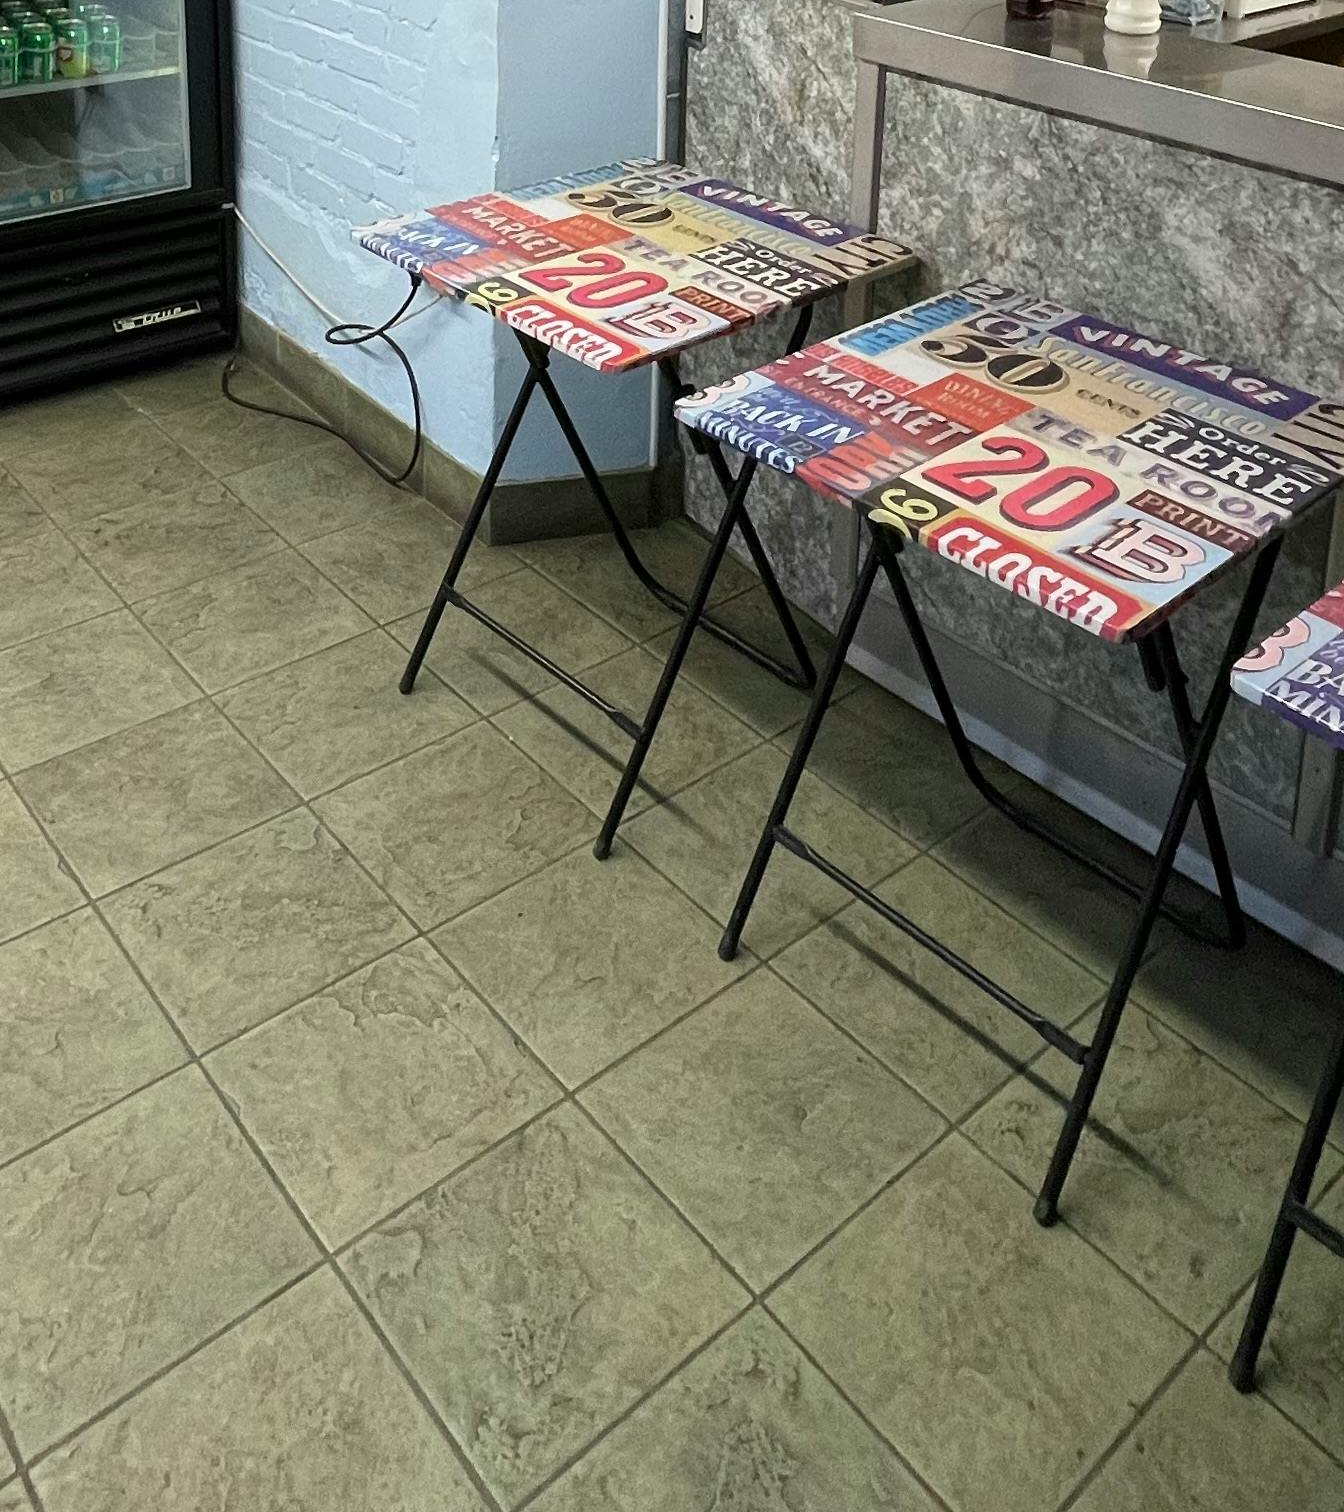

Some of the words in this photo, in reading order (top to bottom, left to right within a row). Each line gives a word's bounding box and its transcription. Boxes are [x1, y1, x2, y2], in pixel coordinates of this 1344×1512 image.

[462, 206, 576, 258] MARKET
[703, 185, 844, 239] VINTAGE
[518, 253, 669, 309] 20
[695, 246, 813, 297] HERE
[673, 288, 749, 321] PRINT
[508, 304, 623, 371] CLOSED
[1077, 324, 1291, 407] VINTAGE
[804, 365, 974, 446] MARKET
[808, 424, 864, 444] IN
[1032, 413, 1127, 466] TEA
[1199, 427, 1288, 466] Order
[921, 436, 1120, 532] 20
[1122, 421, 1312, 506] HERE
[1137, 494, 1250, 545] PRINT
[936, 526, 1118, 637] CLOSED
